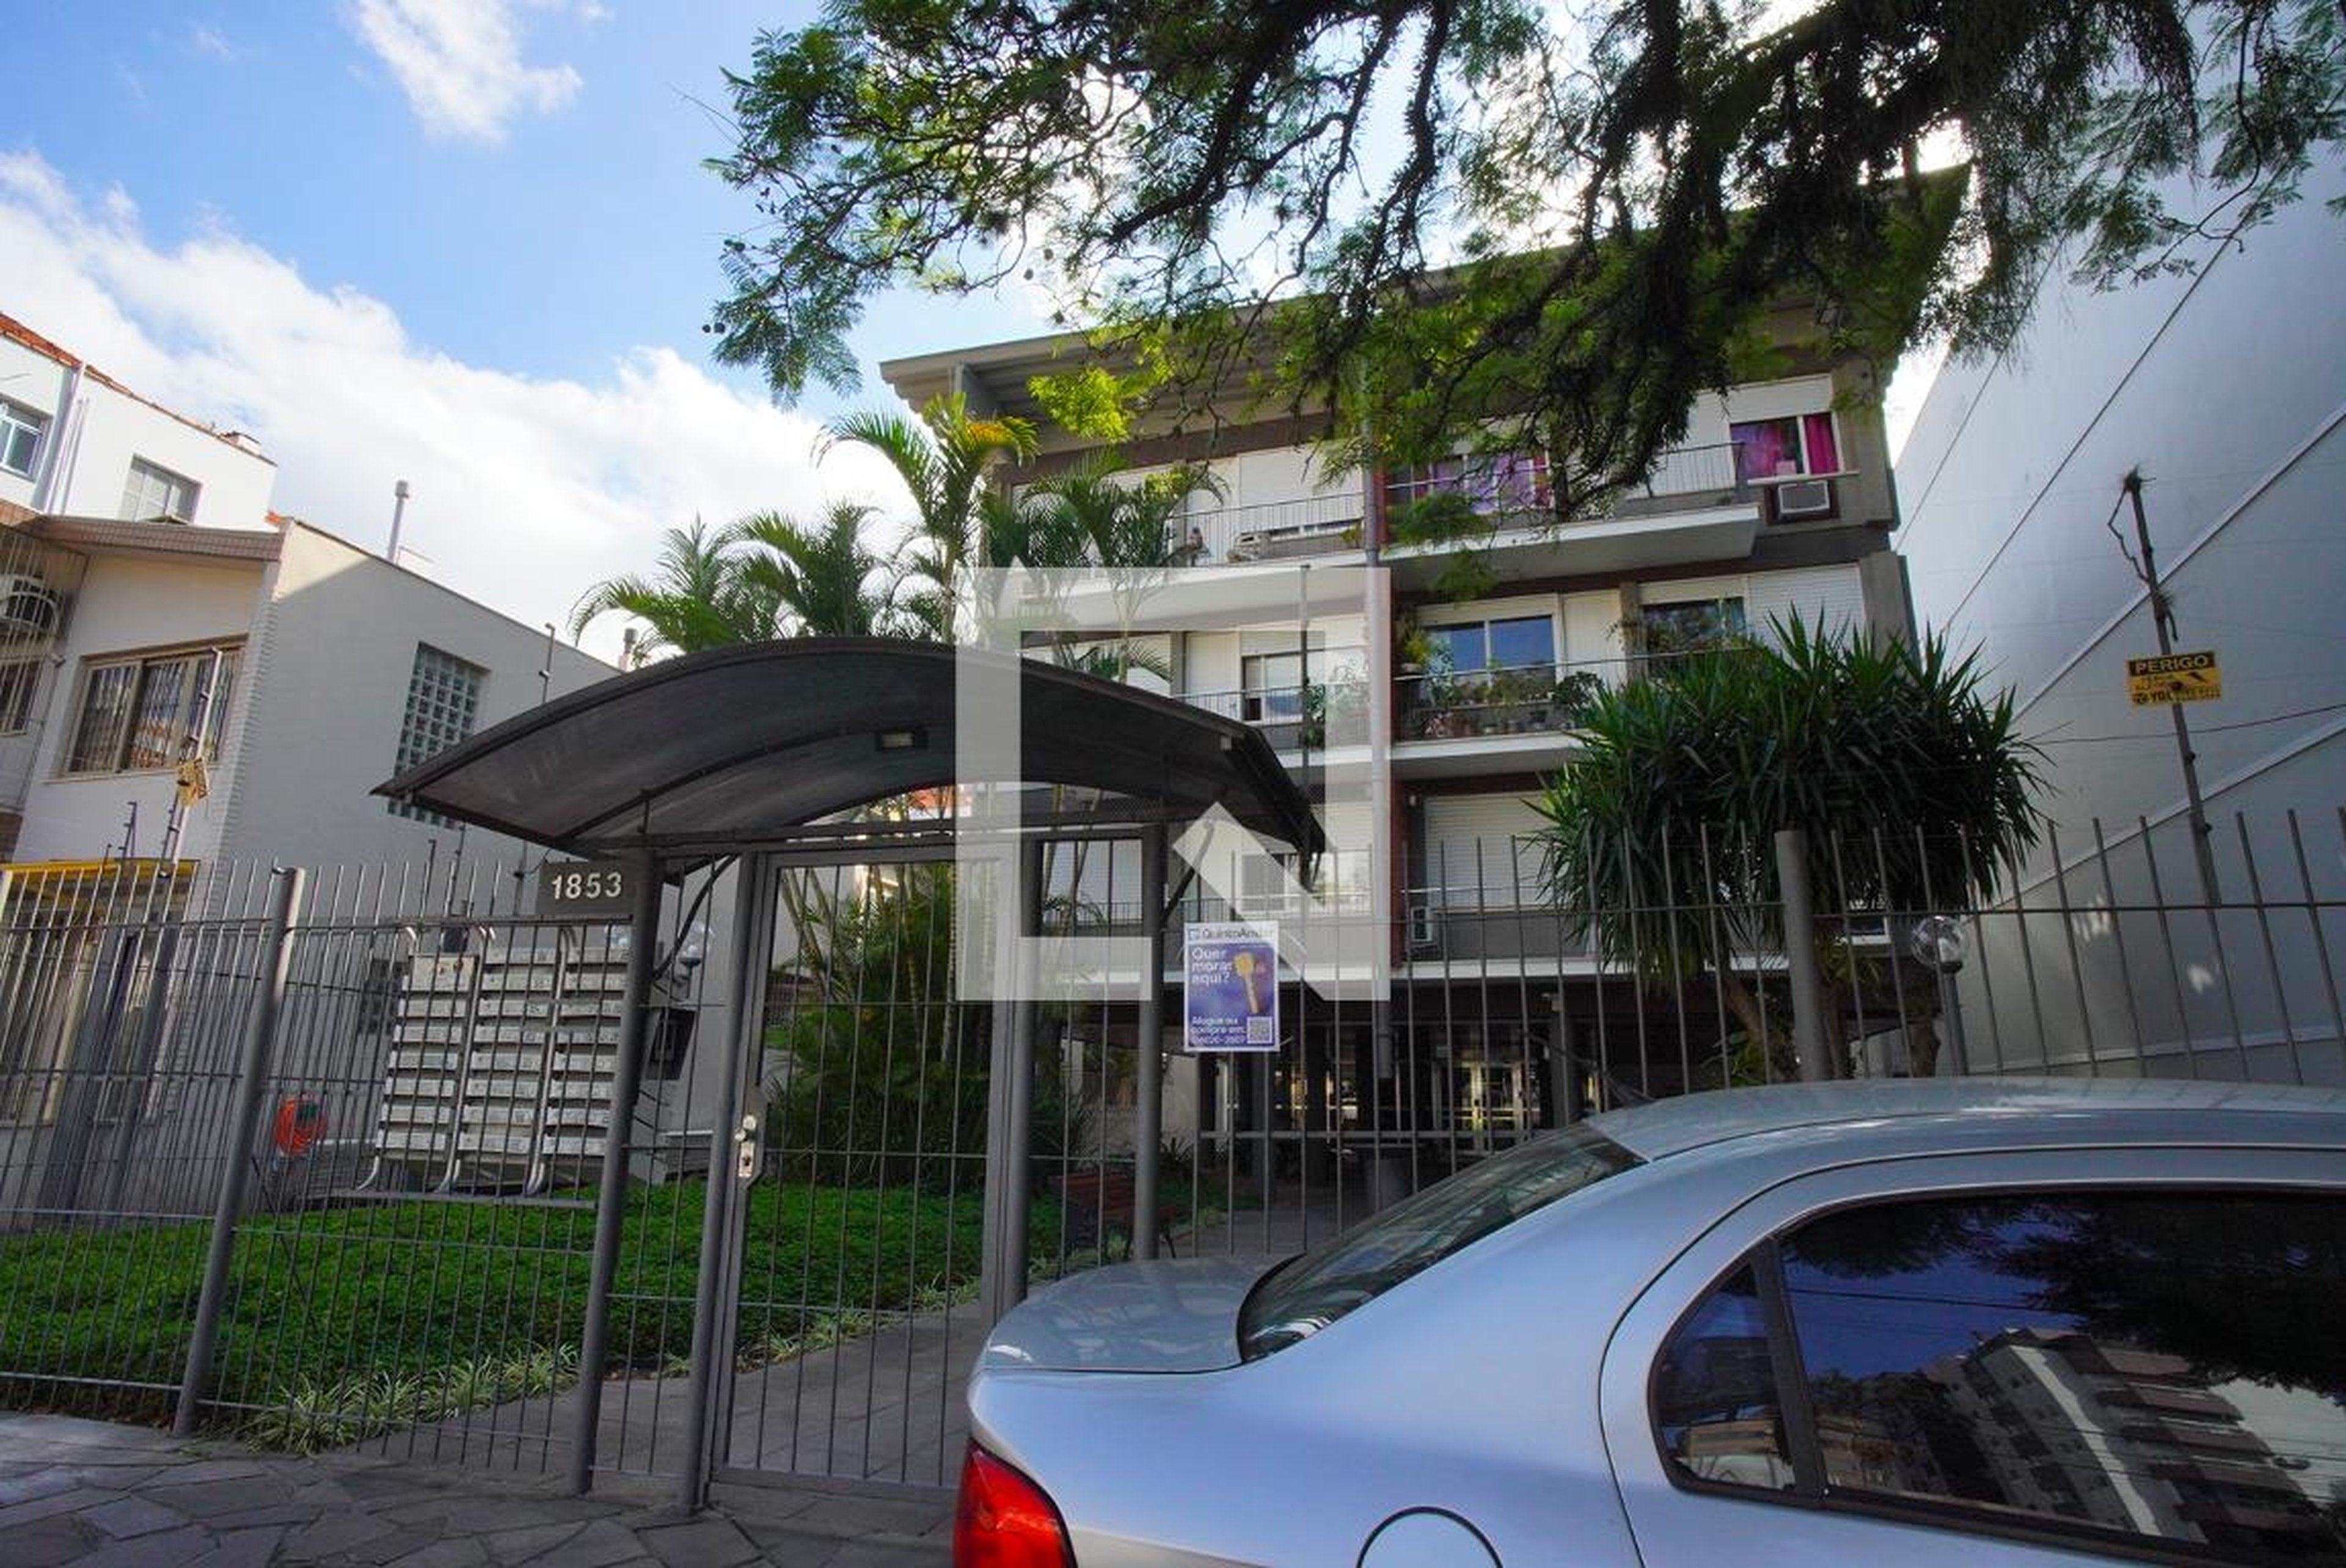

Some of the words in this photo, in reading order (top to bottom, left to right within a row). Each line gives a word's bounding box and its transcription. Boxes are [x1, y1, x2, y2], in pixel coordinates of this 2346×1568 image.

[2136, 655, 2209, 674] PERIGO
[552, 872, 622, 900] 1853
[1192, 947, 1227, 960] Quer
[1192, 961, 1232, 972] morar
[1192, 972, 1230, 986] aqui?
